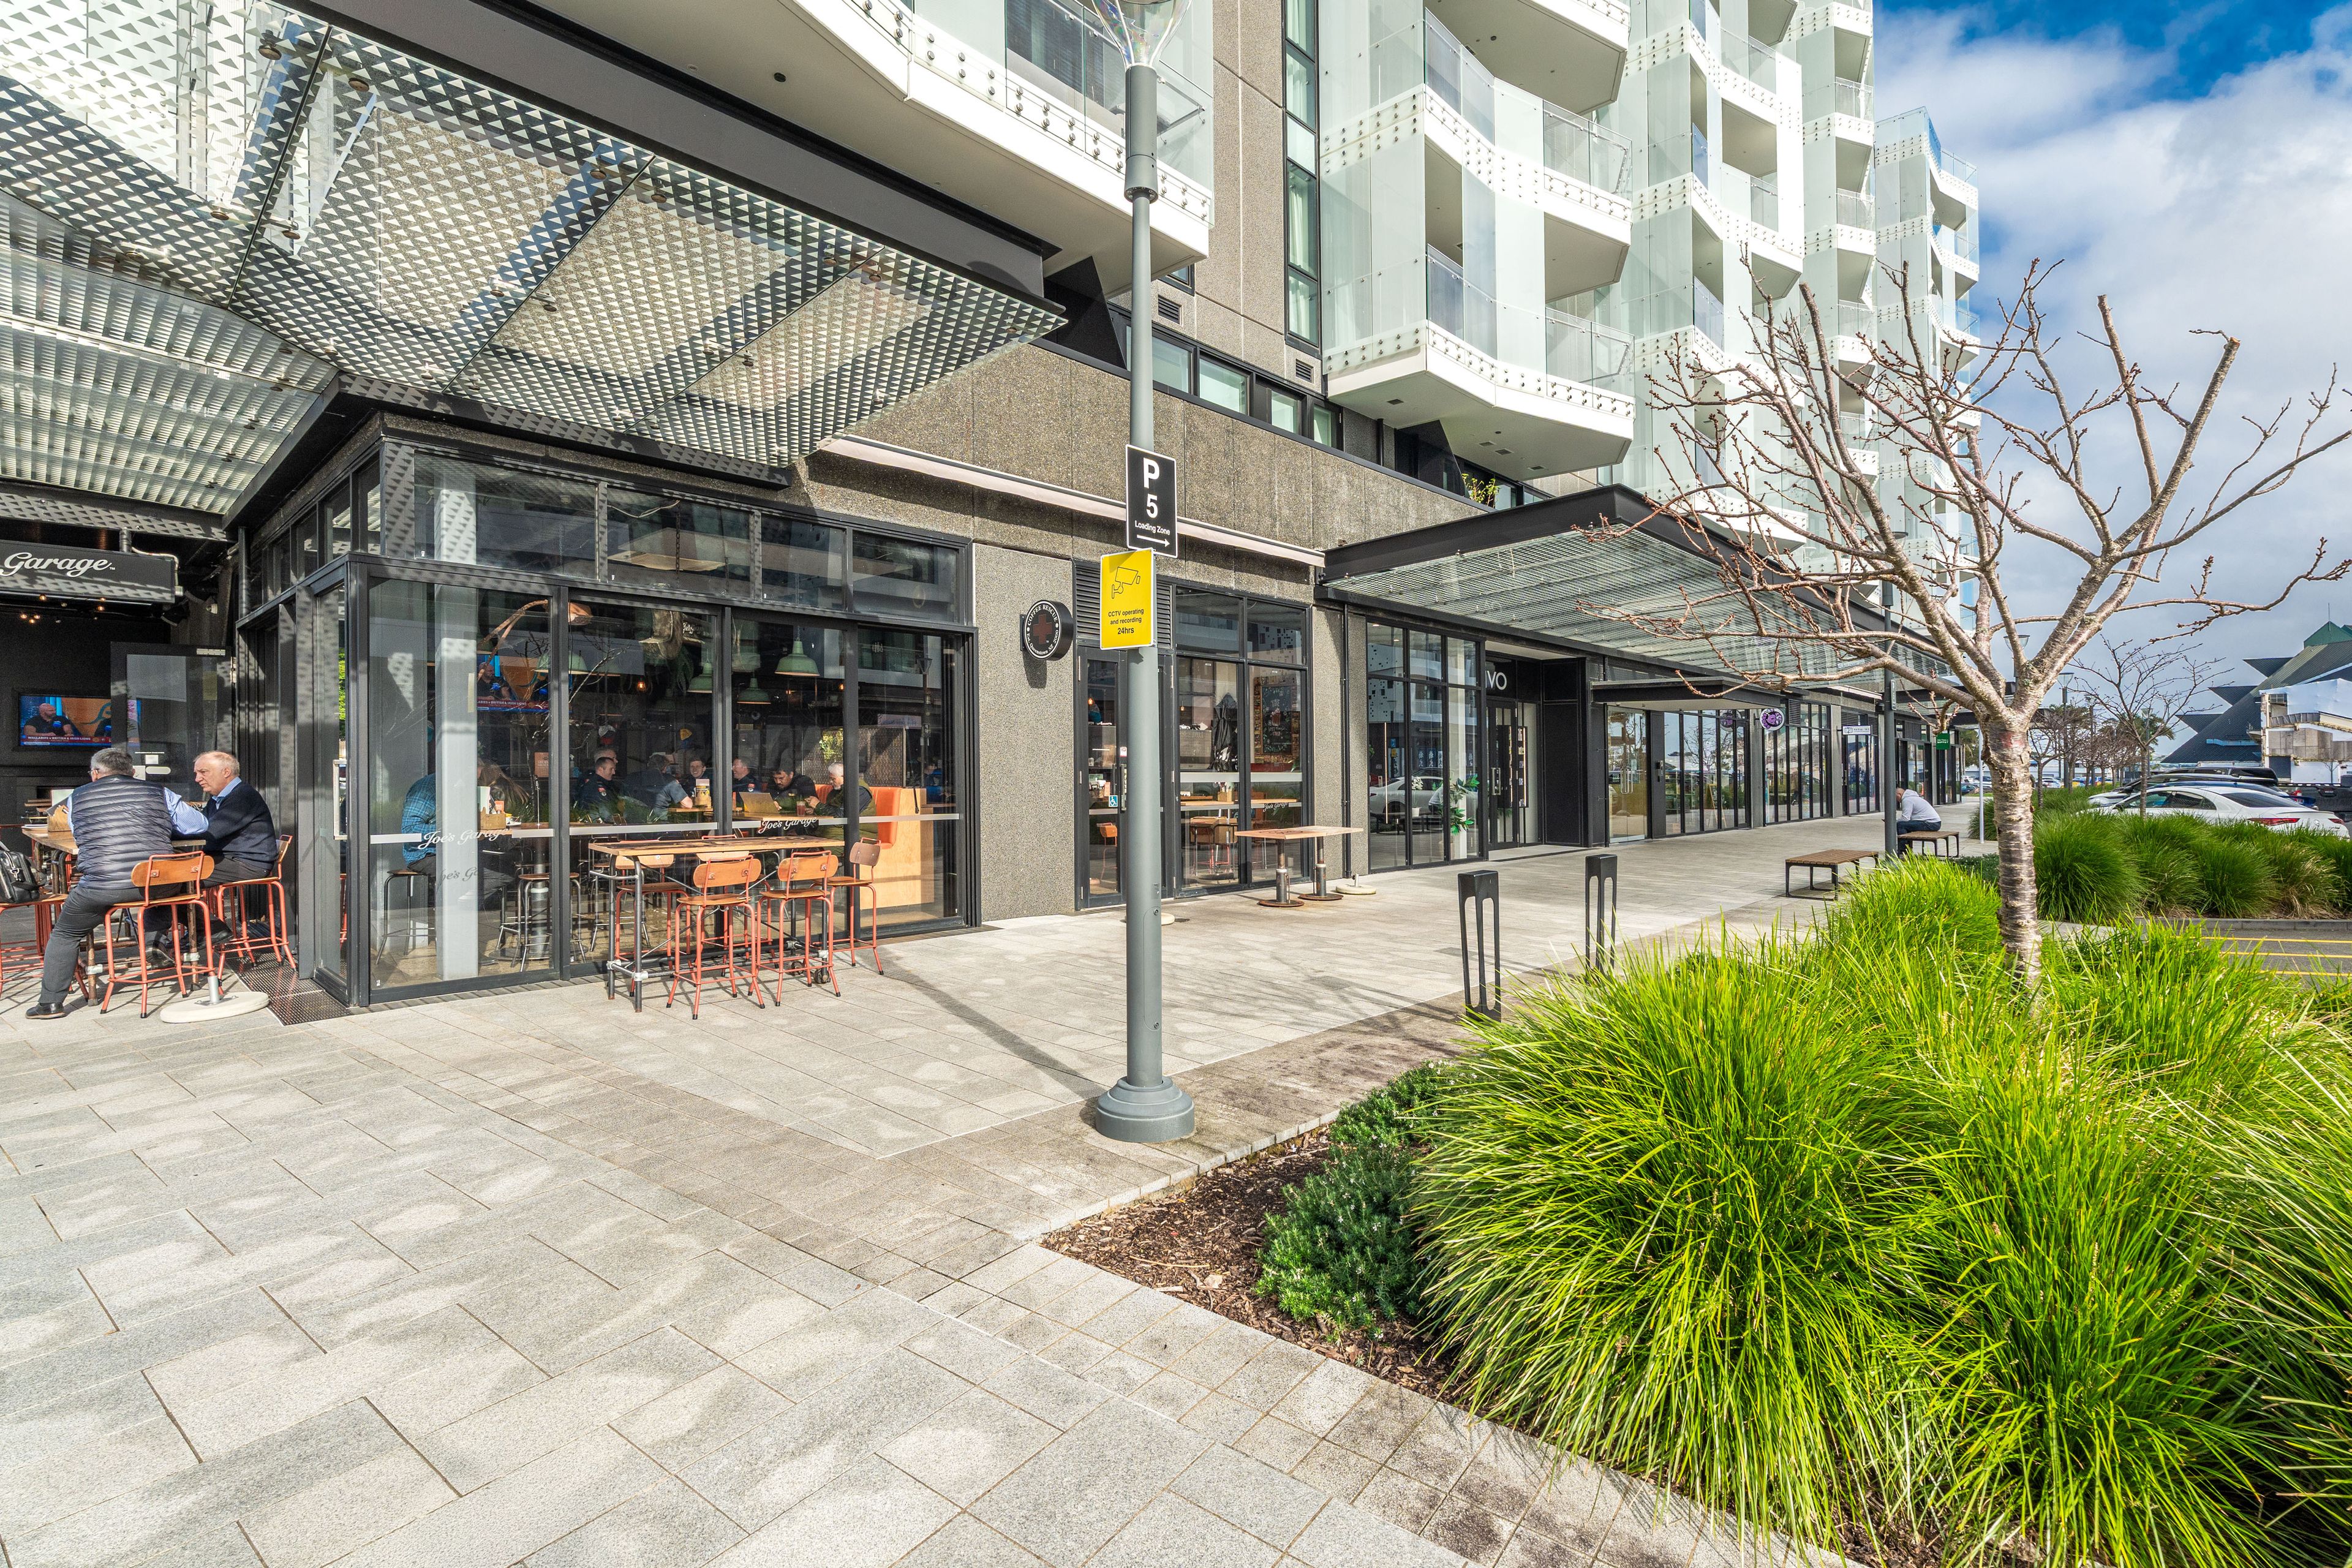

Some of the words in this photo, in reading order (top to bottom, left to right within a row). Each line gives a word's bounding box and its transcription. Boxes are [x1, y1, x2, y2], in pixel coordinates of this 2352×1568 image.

[1143, 457, 1160, 489] P
[1146, 493, 1158, 518] 5
[1134, 520, 1156, 533] Loading
[1156, 527, 1170, 535] Zone
[0, 552, 112, 578] Garage
[1027, 605, 1042, 626] COFFEE
[1042, 604, 1058, 622] RESCUE
[1030, 643, 1048, 655] Queenstown
[758, 820, 783, 834] Joe's
[783, 816, 818, 831] Garage
[418, 831, 456, 850] Joe's
[458, 829, 510, 845] Garage
